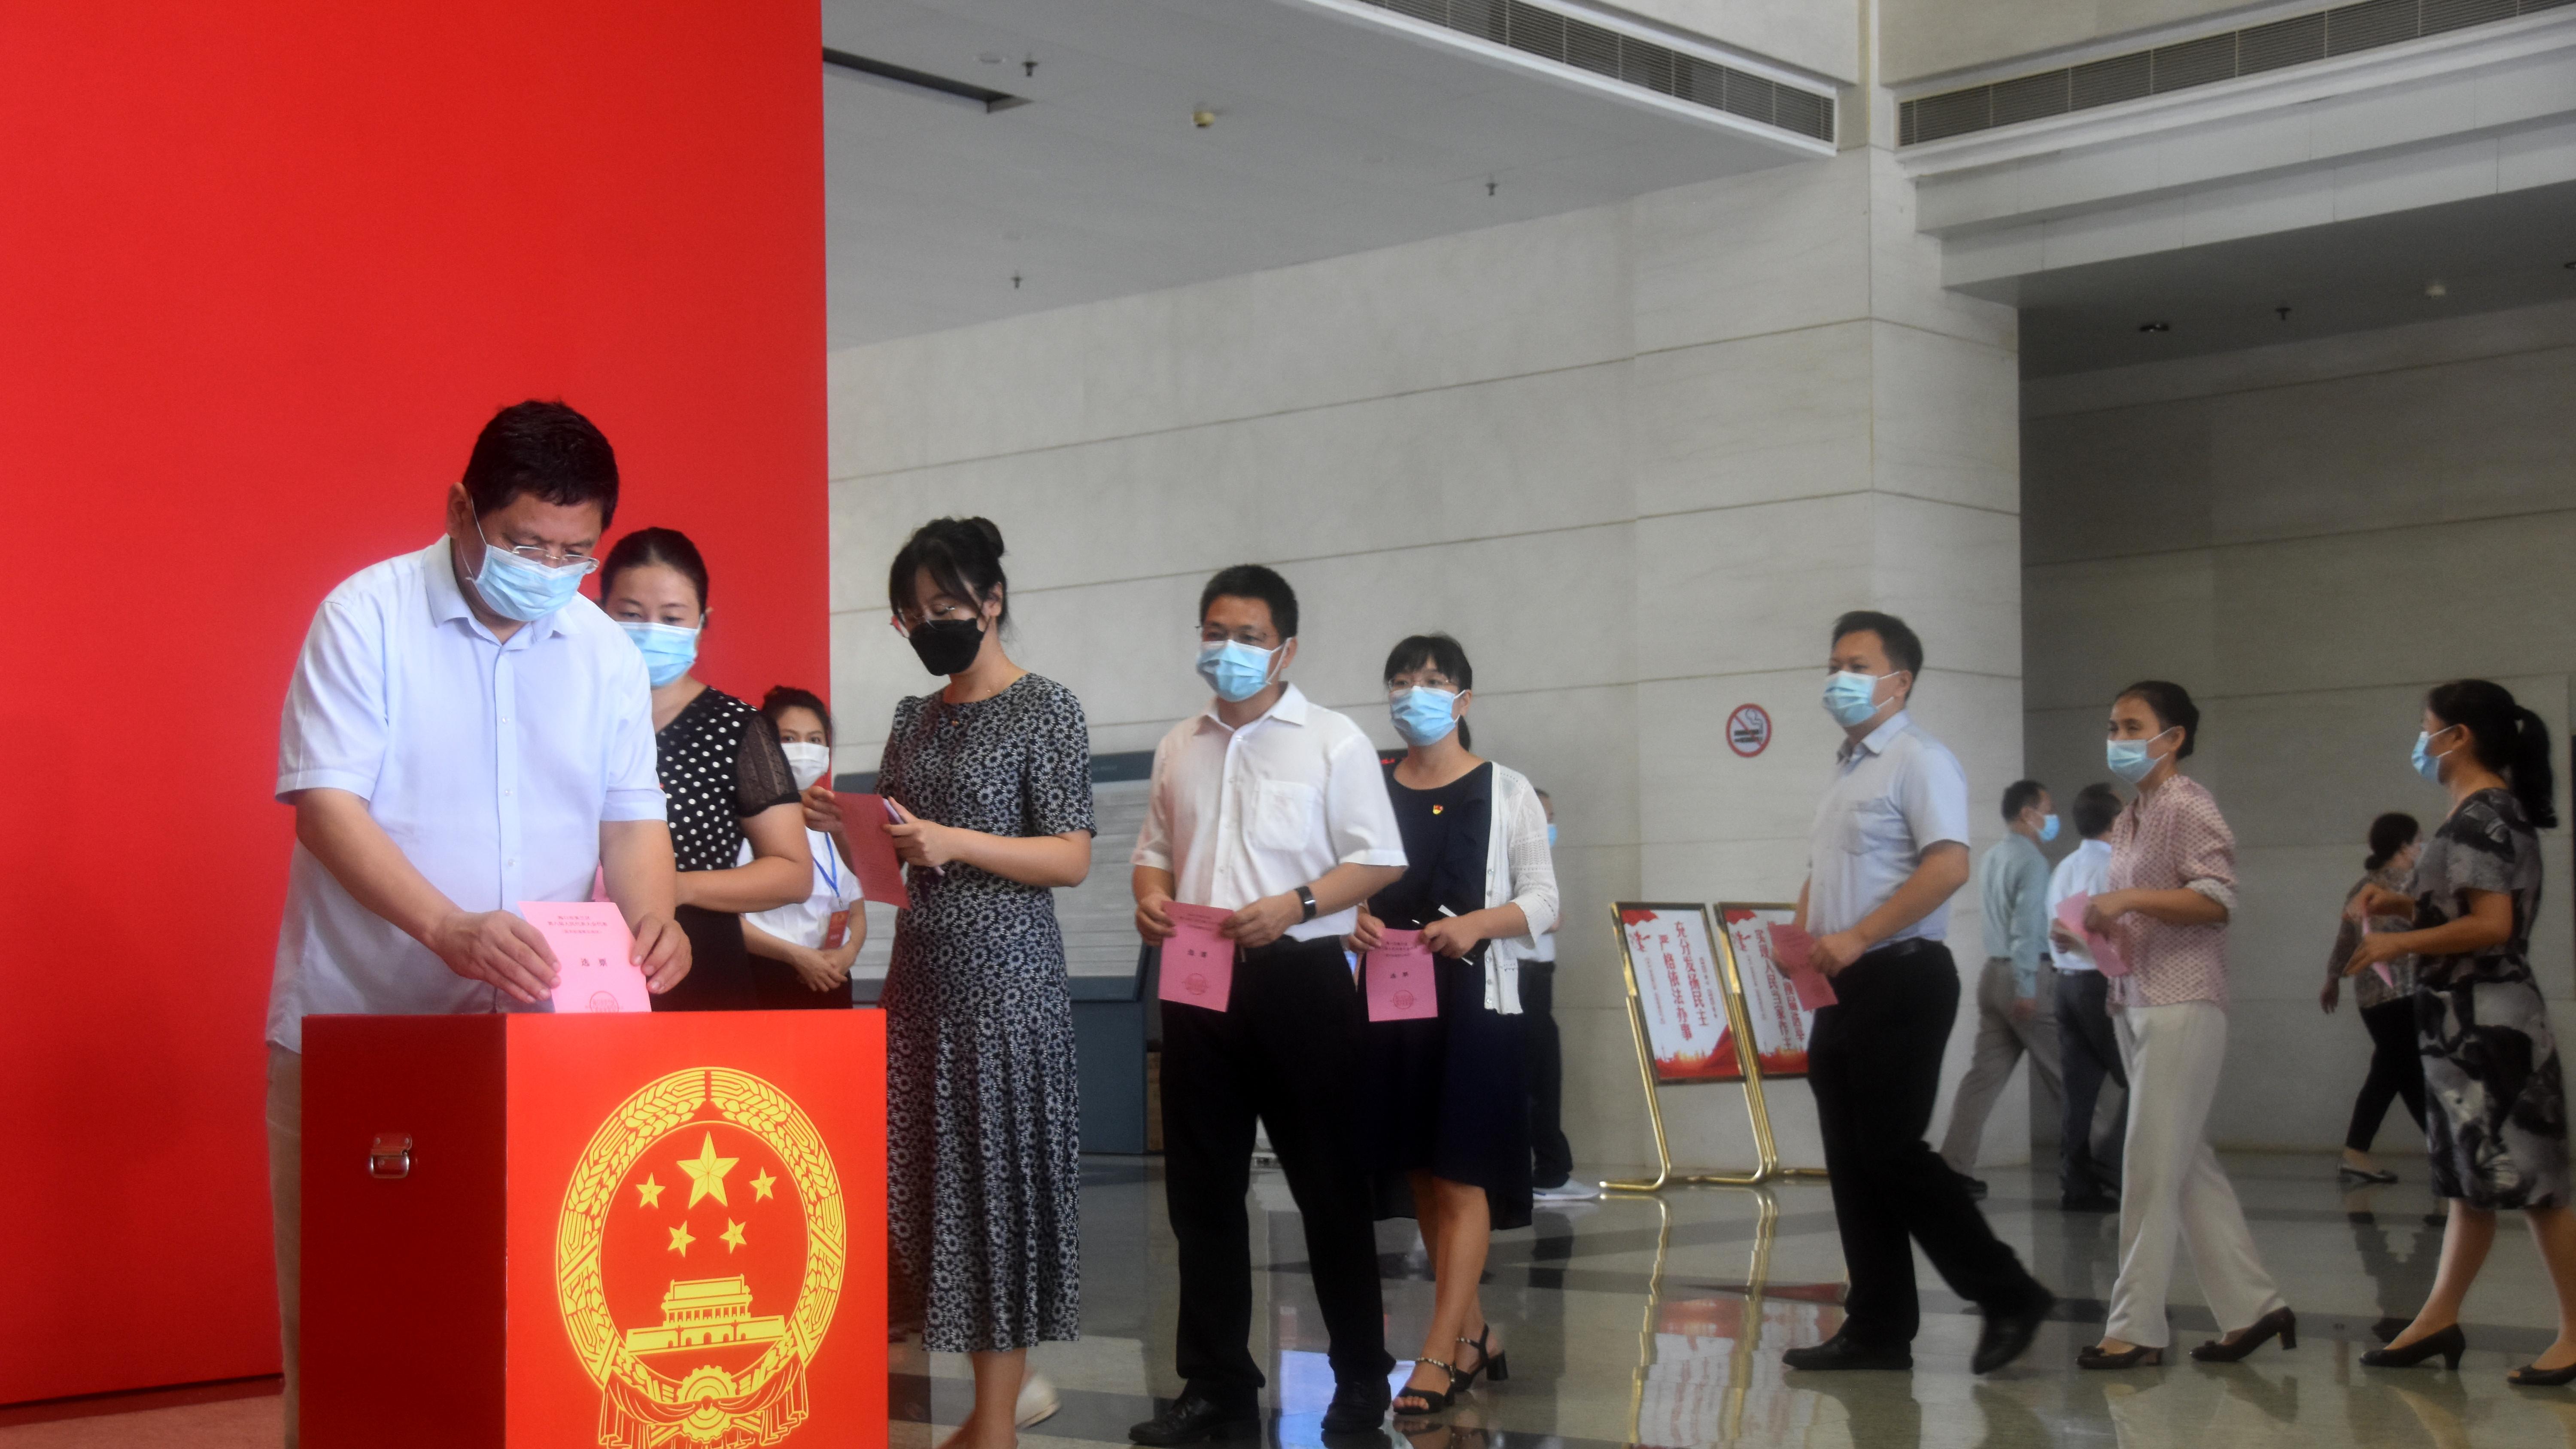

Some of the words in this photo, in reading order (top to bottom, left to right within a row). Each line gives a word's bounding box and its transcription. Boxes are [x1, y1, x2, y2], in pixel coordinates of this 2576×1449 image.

[1659, 934, 1692, 1041] 严格依法办事
[1676, 921, 1709, 1026] 充分发扬民主
